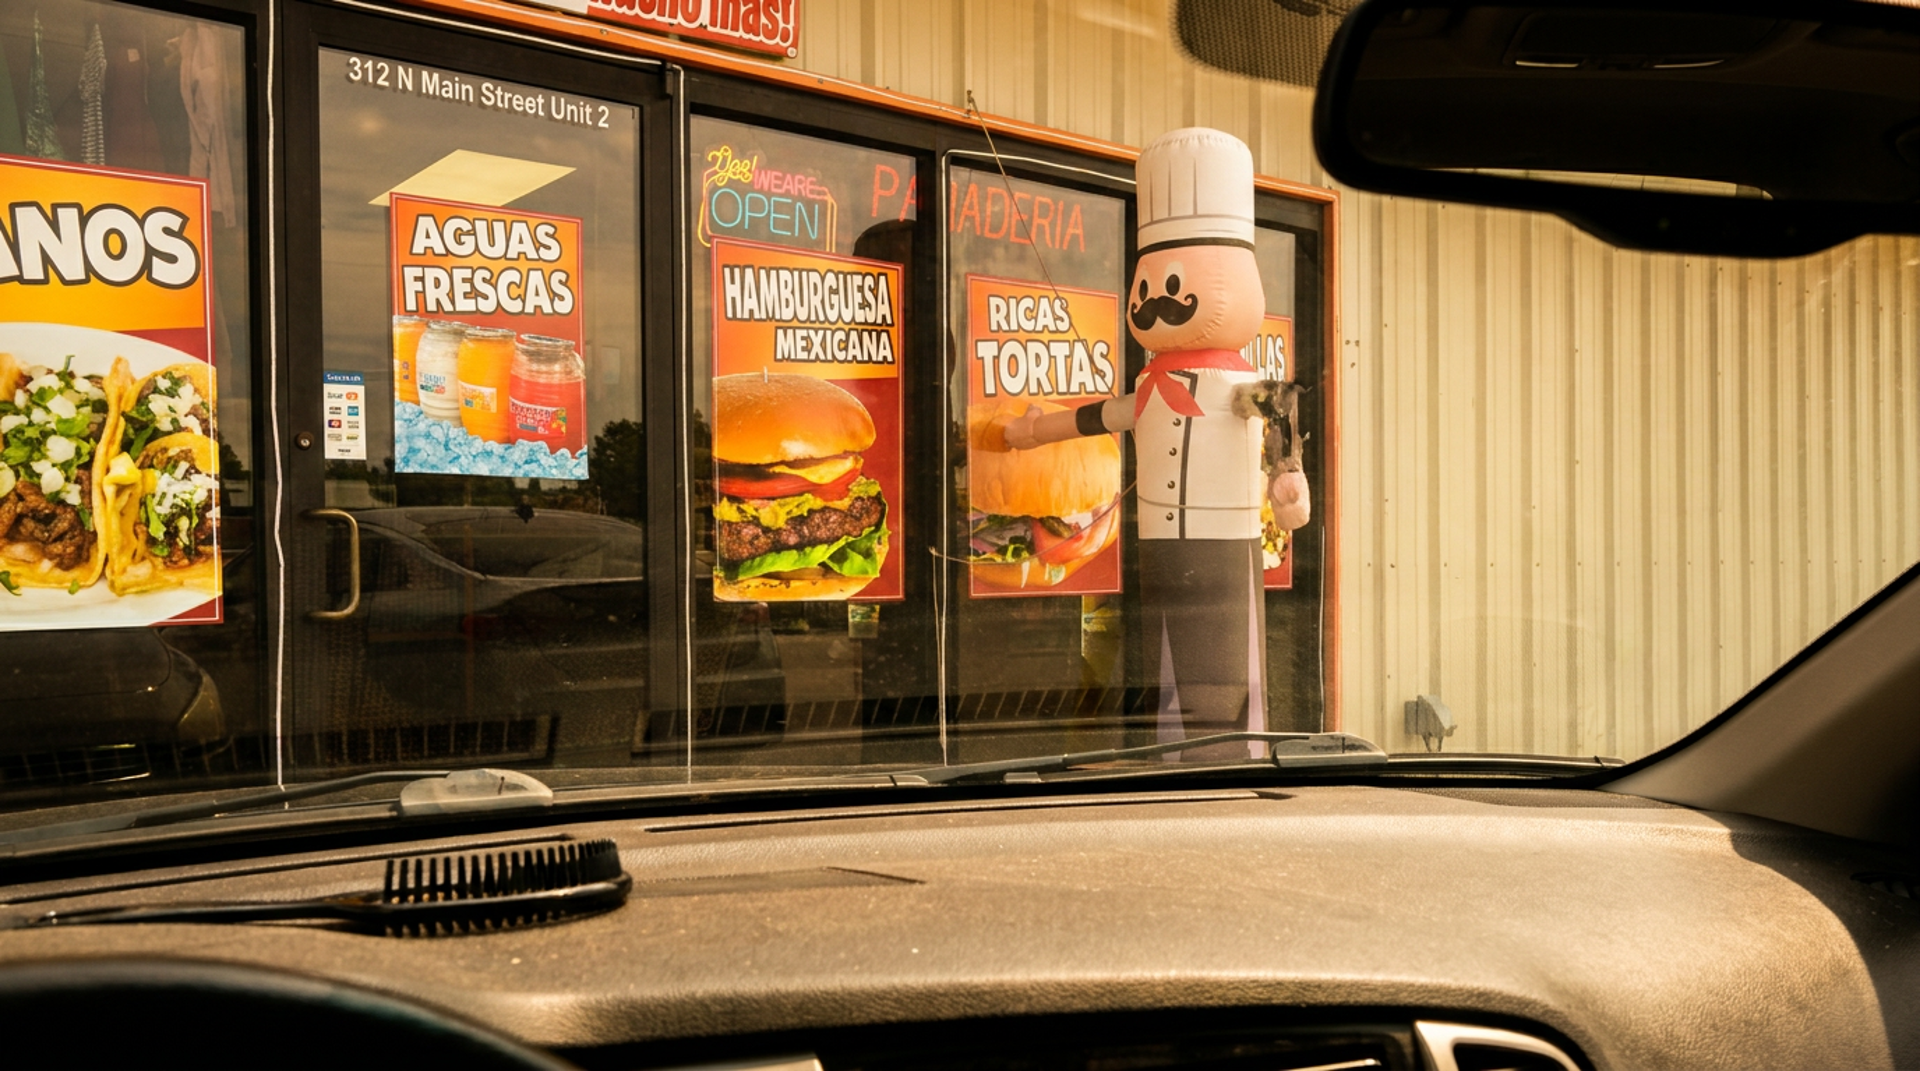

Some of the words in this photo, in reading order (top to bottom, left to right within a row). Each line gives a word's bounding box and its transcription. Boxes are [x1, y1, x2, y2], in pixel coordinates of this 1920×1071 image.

[348, 56, 390, 87] 312
[397, 65, 413, 92] N
[421, 70, 474, 103] Main
[480, 81, 545, 117] Street
[550, 96, 593, 126] Unit
[597, 105, 609, 129] 2
[711, 187, 819, 240] OPEN
[871, 163, 1085, 253] PAADERIA
[0, 201, 201, 290] NOS
[410, 213, 562, 262] AGUAS
[402, 264, 575, 316] FRESCAS
[722, 264, 894, 326] HAMBURGUESA
[988, 294, 1071, 333] RICAS
[774, 326, 895, 364] MEXICANA
[975, 339, 1115, 397] TORTAS
